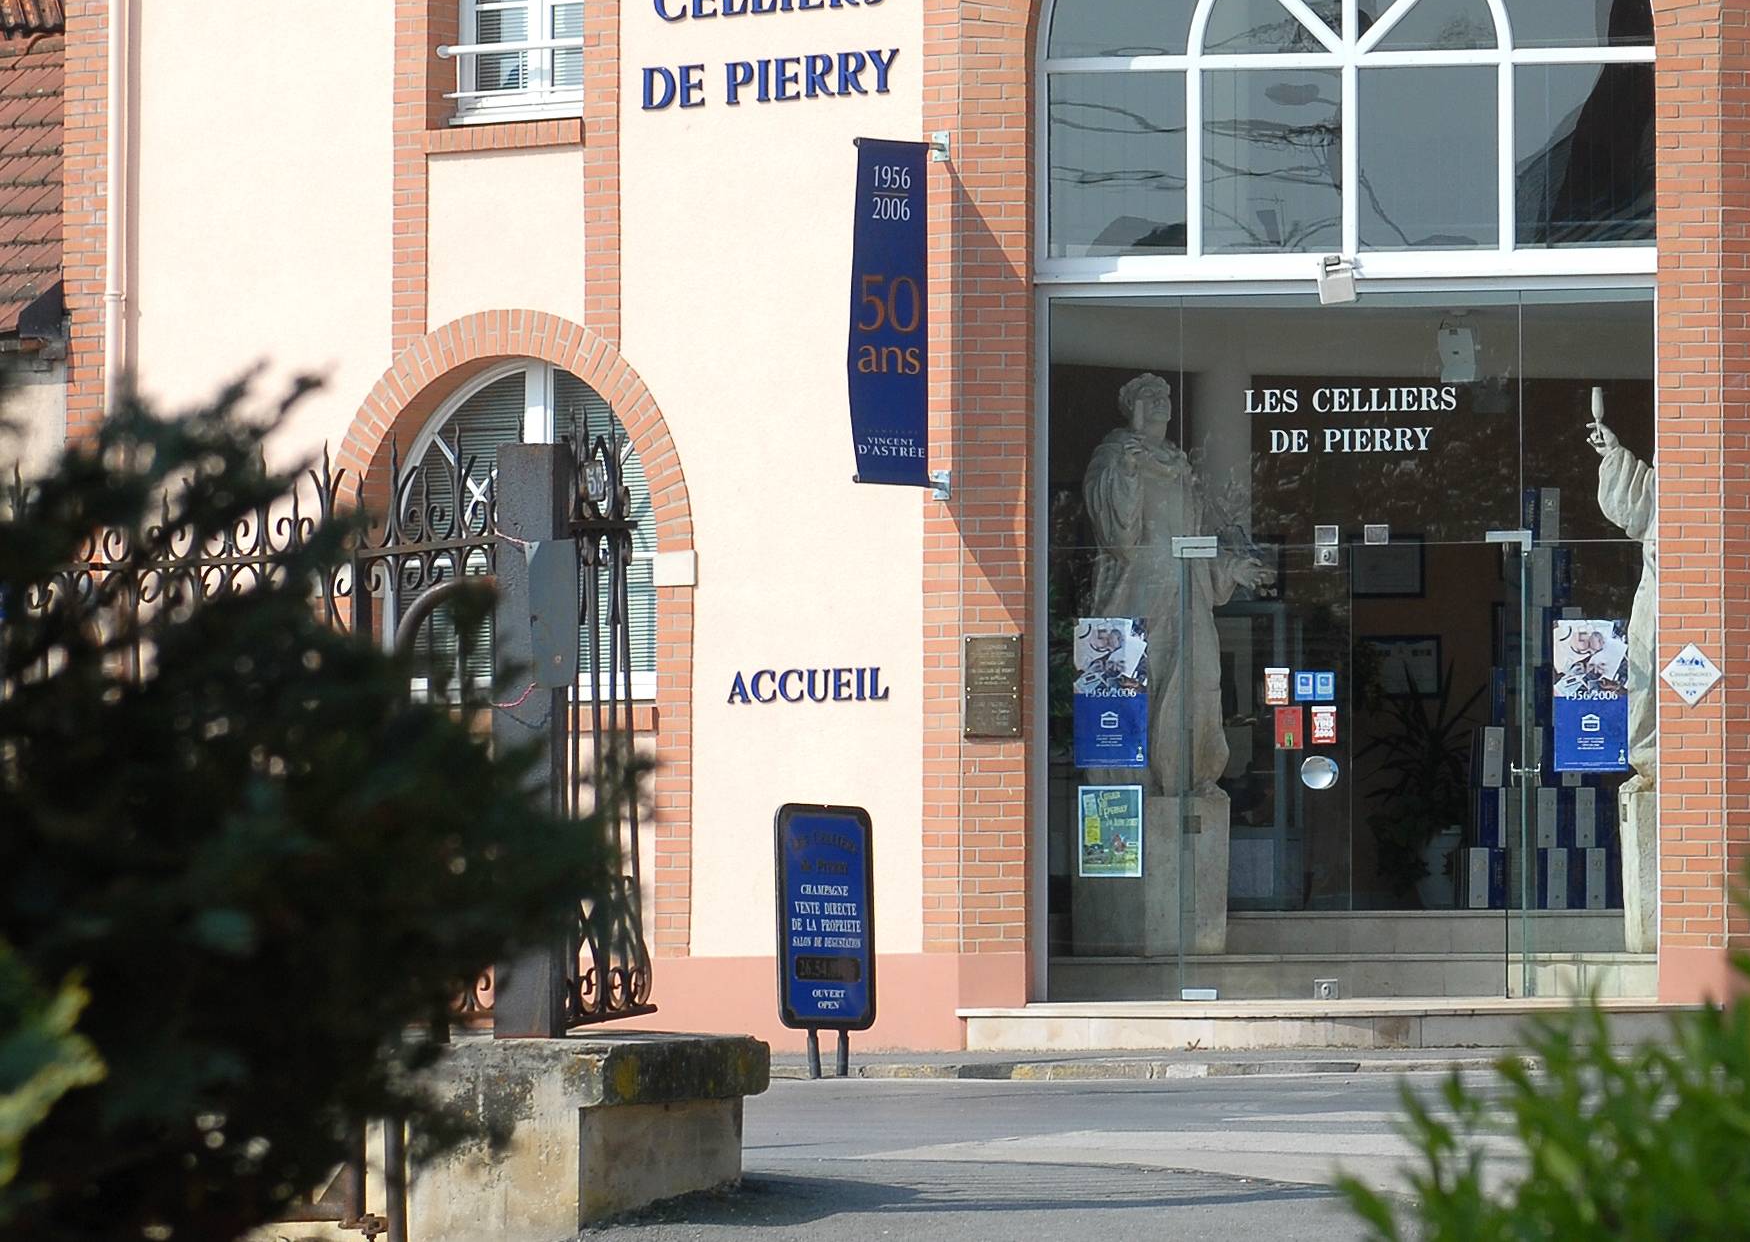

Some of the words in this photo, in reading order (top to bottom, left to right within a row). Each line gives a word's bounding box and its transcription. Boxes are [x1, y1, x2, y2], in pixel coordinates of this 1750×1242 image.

[641, 63, 705, 110] DE
[725, 48, 900, 106] PIERRY
[873, 164, 911, 190] 1956
[872, 196, 911, 222] 2006
[858, 274, 922, 334] 50
[857, 344, 921, 375] ans
[1244, 388, 1299, 414] LES
[1312, 386, 1457, 413] CELLIERS
[867, 437, 914, 446] VINCENT
[1270, 429, 1309, 454] DE
[1323, 426, 1433, 454] PIERRY
[727, 666, 890, 704] ACCUEIL
[1565, 689, 1618, 701] 1956/2006
[801, 884, 849, 896] CHAMPAGNE
[795, 901, 820, 915] VENTE
[824, 902, 857, 916] DIRECTE
[791, 918, 803, 931] DE
[806, 918, 817, 932] LA
[792, 936, 811, 947] SALON
[812, 989, 846, 998] OUVERT
[817, 1000, 840, 1009] OPEN
